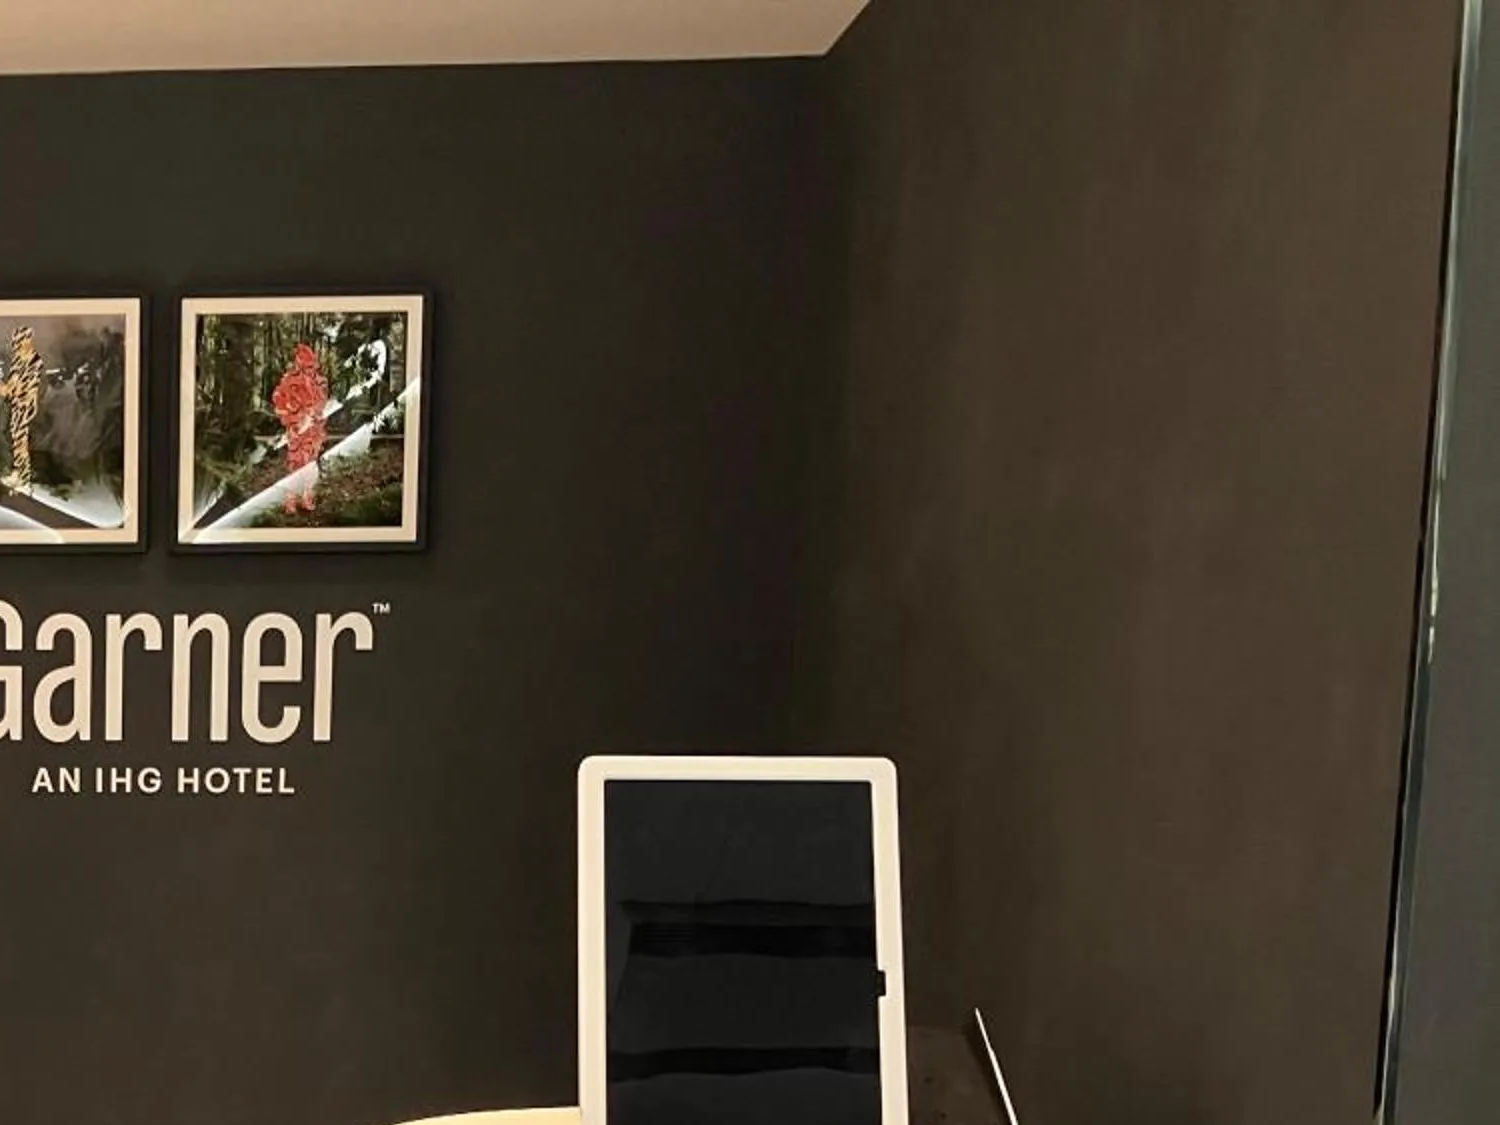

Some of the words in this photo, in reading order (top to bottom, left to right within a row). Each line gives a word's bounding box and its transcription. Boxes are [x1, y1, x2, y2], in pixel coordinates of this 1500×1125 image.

[31, 766, 82, 794] AN
[95, 766, 163, 794] IHG
[177, 766, 295, 794] HOTEL
